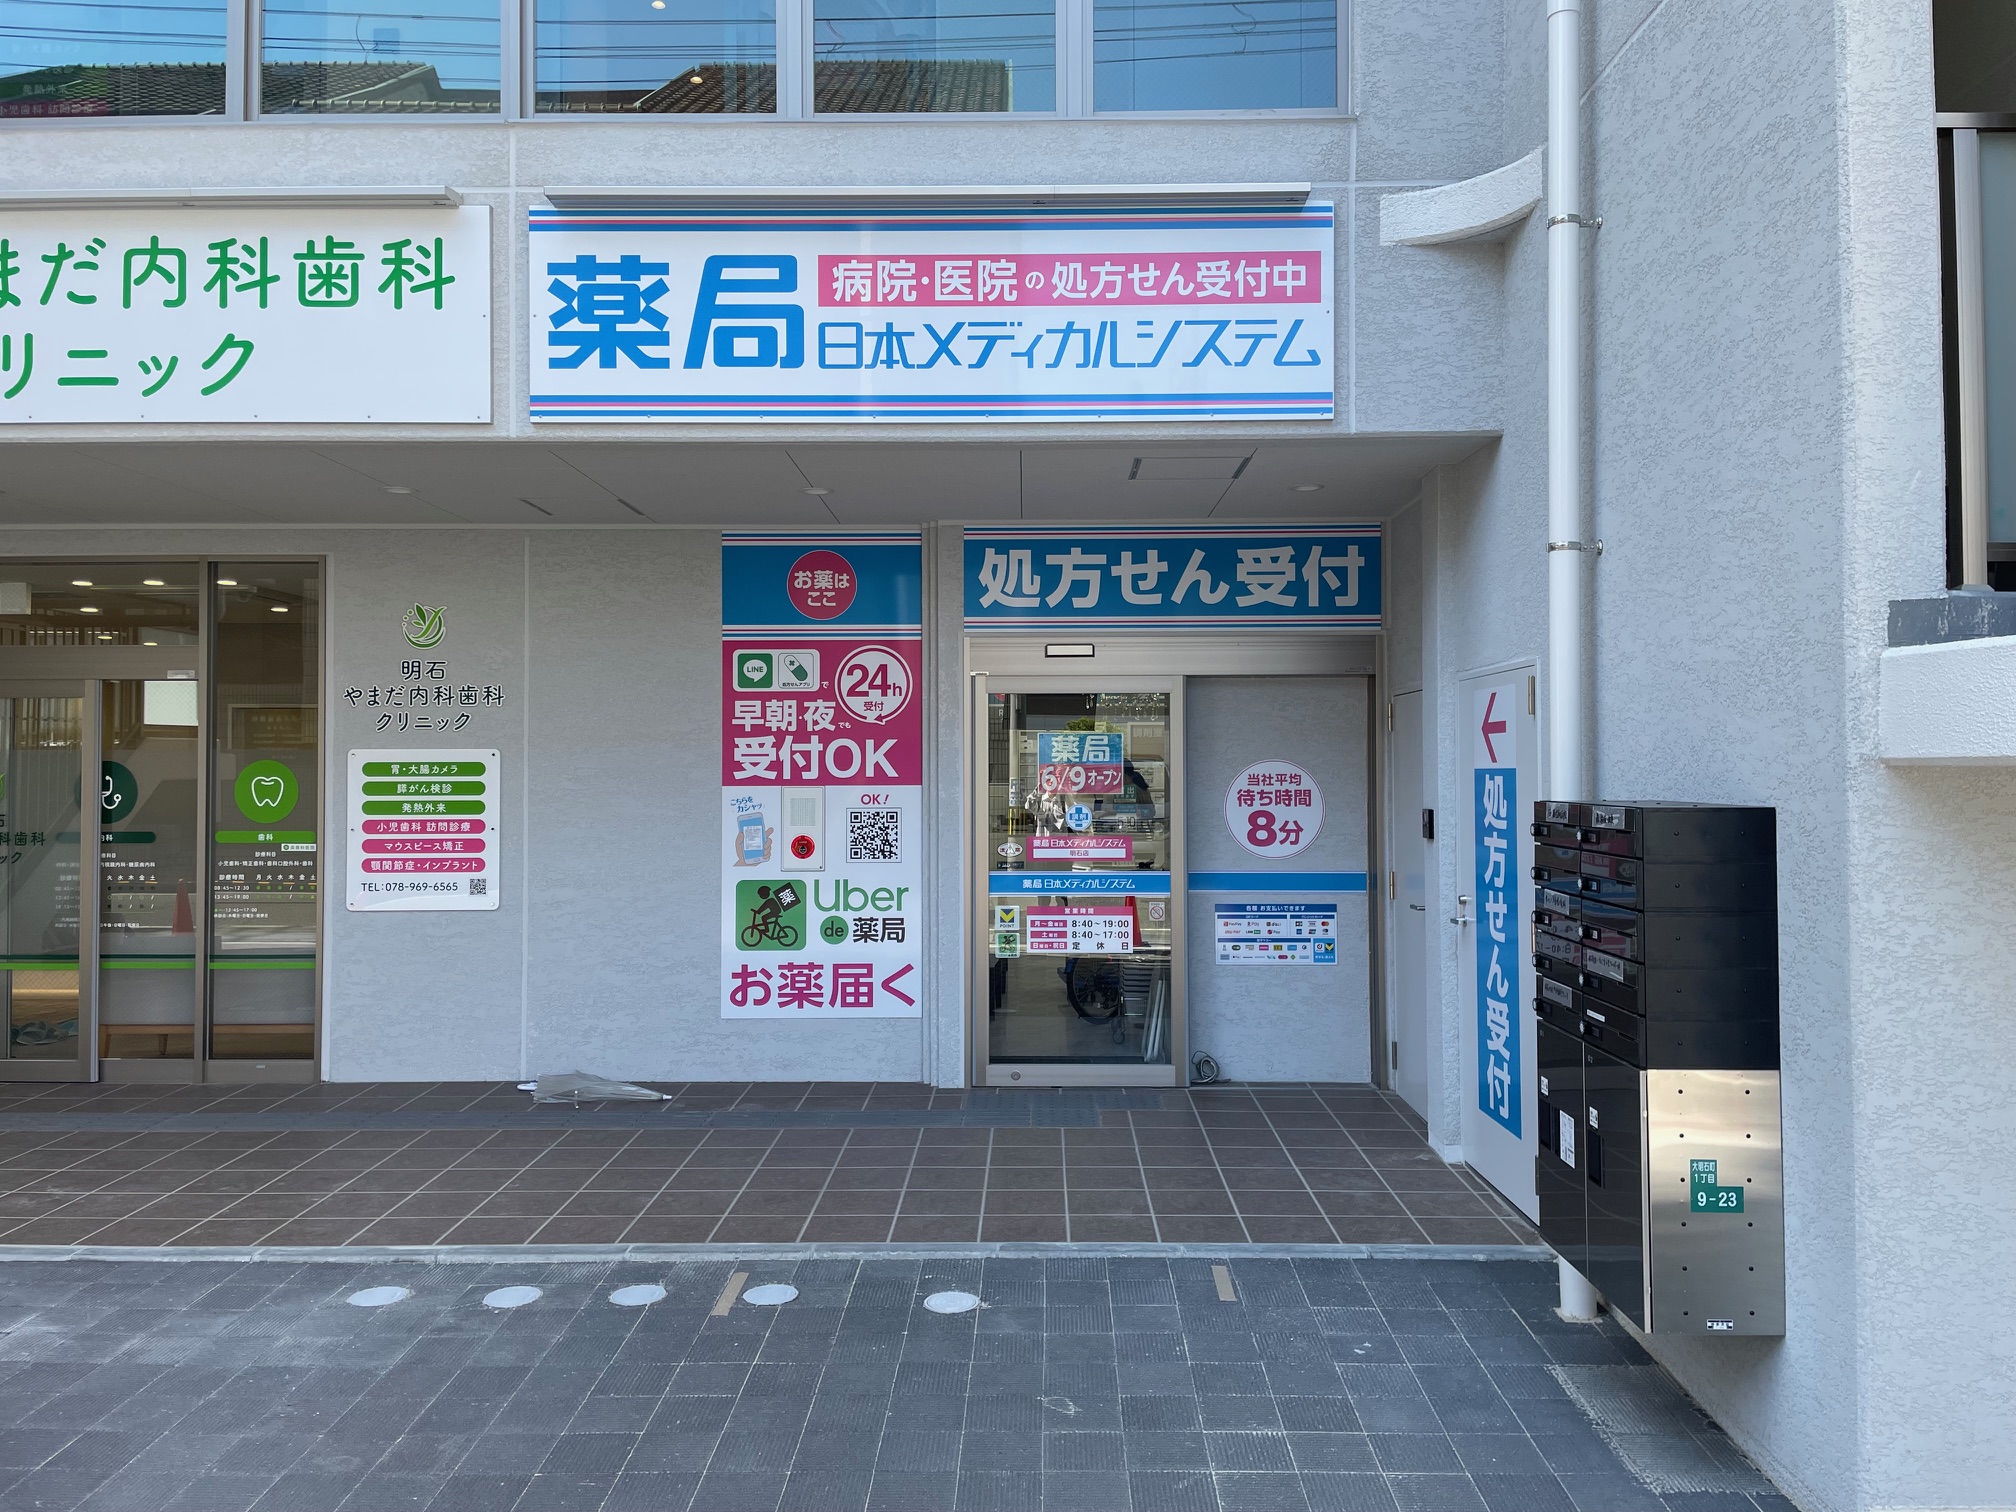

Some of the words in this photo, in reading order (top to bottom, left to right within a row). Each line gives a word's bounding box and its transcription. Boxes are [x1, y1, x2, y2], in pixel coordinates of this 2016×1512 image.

[832, 257, 1308, 302] 病院・医院の処方せん受付中
[546, 254, 804, 370] 薬局
[818, 316, 1322, 370] 日本メディカルシステム
[793, 570, 850, 589] お薬は
[977, 544, 1365, 609] 処方せん受付
[807, 591, 836, 607] ここ
[401, 659, 448, 681] 明石
[746, 665, 764, 673] LINE
[846, 663, 903, 698] 24h
[343, 685, 505, 707] やまだ内科歯科
[863, 701, 884, 712] 受付
[376, 711, 472, 732] クリニック
[732, 735, 899, 780] 受付OK
[1051, 735, 1110, 763] 薬局
[390, 764, 459, 775] 胃・大腸カメラ
[1247, 773, 1302, 786] 当社平均
[730, 796, 753, 806] こちらを
[1237, 788, 1312, 807] 待ち時間
[401, 802, 447, 813] 発熱外来
[377, 822, 422, 832] 小児歯科
[426, 822, 471, 832] 訪問診療
[1247, 809, 1304, 847] 8分
[384, 841, 464, 851] マウスピース矯正
[1051, 839, 1126, 847] 日本メディカルシステム
[1069, 849, 1089, 857] 明石店
[1022, 879, 1042, 889] 薬局
[1044, 878, 1136, 889] 日本メディカルシステム
[814, 879, 909, 912] Uber
[824, 920, 844, 937] de
[852, 917, 906, 943] 薬局
[1481, 772, 1512, 1119] 処方せん受付
[729, 962, 916, 1009] お薬届く
[1691, 1161, 1716, 1172] 大明石町
[1694, 1173, 1715, 1184] 1丁目
[1697, 1192, 1738, 1208] 9-23
